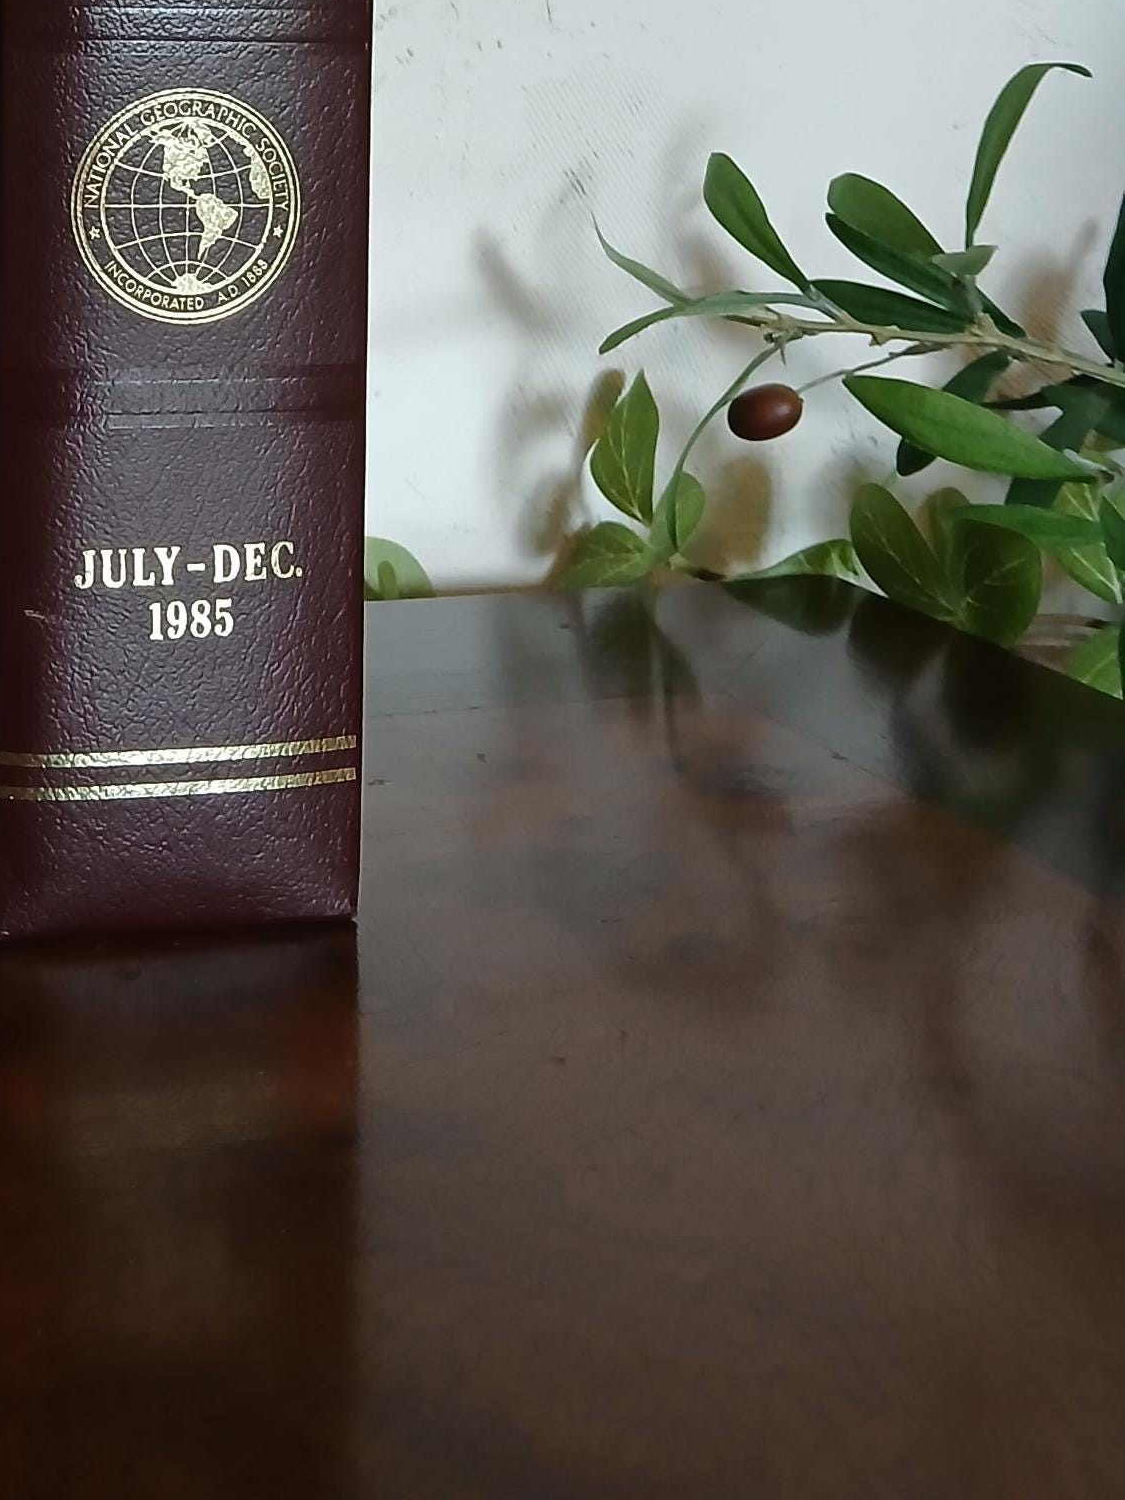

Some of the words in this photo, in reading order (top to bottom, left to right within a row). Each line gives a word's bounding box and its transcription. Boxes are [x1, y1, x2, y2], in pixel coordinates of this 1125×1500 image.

[85, 125, 138, 209] NATIONAL
[140, 101, 256, 139] GEOGRAPHIC
[255, 137, 289, 211] SOCIETY
[105, 260, 204, 310] INCORPORATED
[216, 284, 240, 303] A.D.
[241, 259, 268, 288] 1888
[148, 599, 235, 641] 1985
